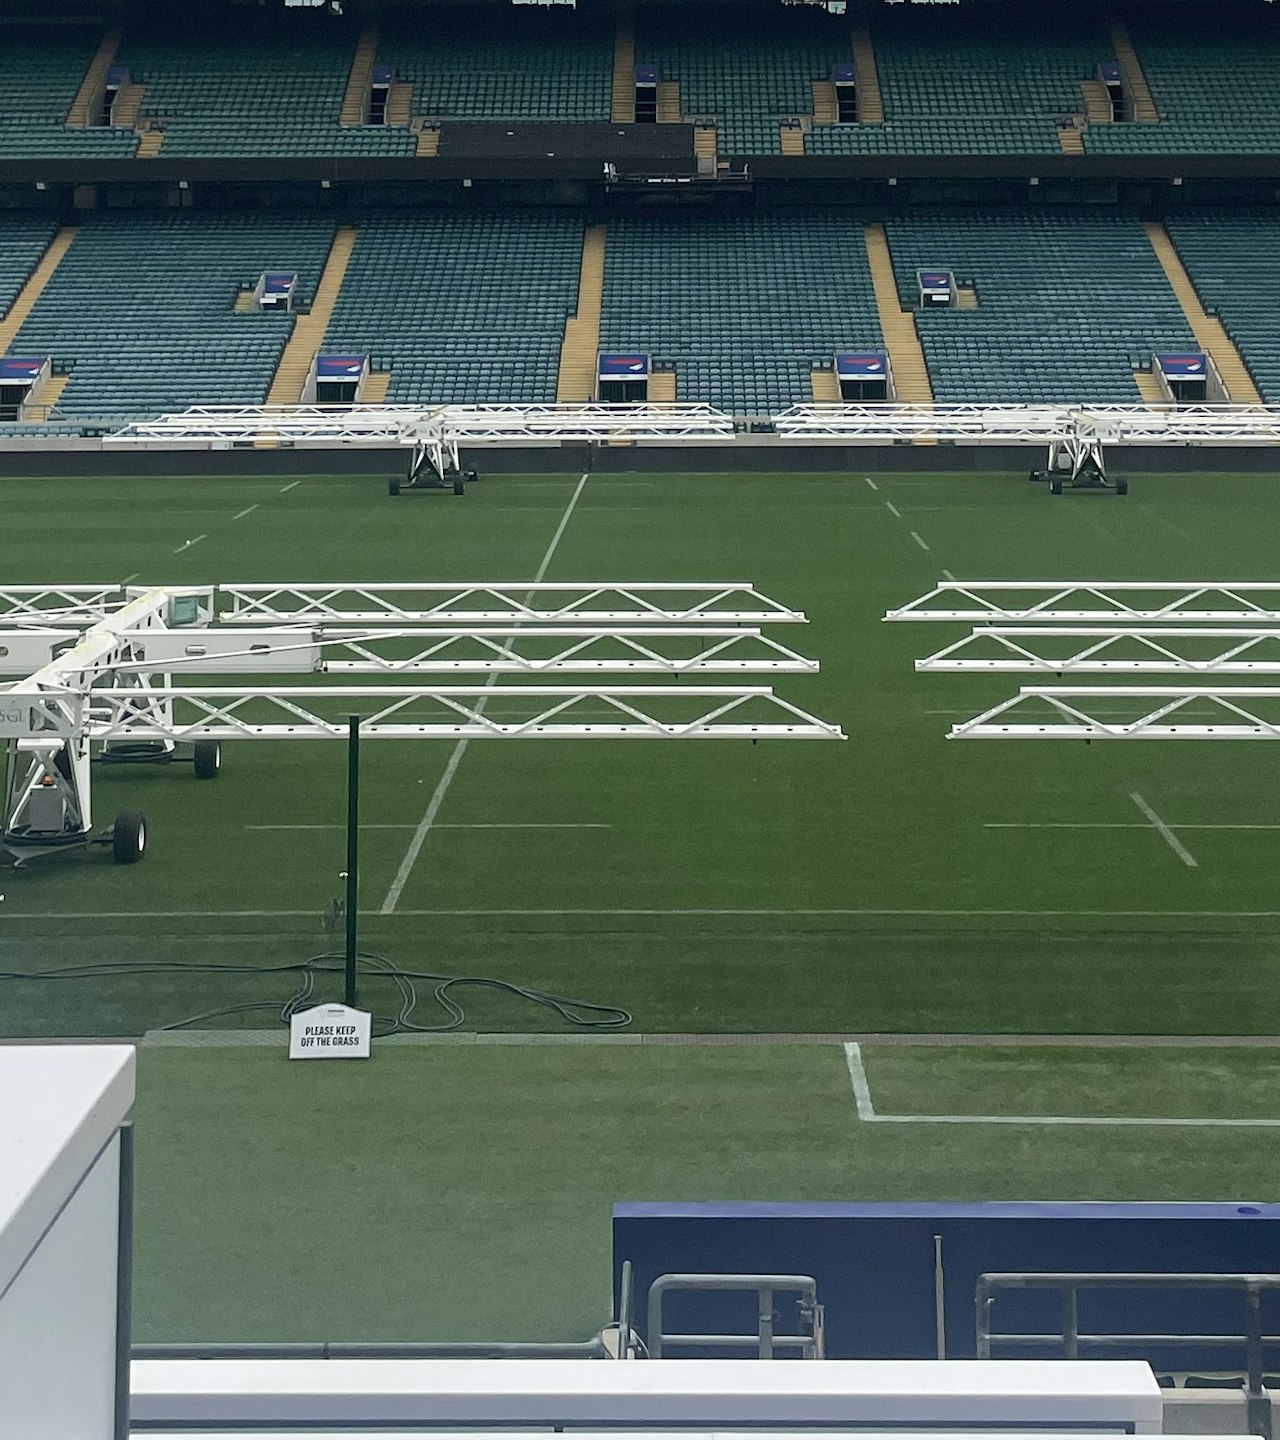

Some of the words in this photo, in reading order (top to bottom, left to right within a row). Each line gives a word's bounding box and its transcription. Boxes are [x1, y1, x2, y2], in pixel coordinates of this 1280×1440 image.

[305, 1026, 334, 1035] PLEASE
[336, 1026, 356, 1035] KEEP
[301, 1037, 314, 1047] OFF
[316, 1037, 330, 1046] THE
[332, 1036, 359, 1046] GRASS
